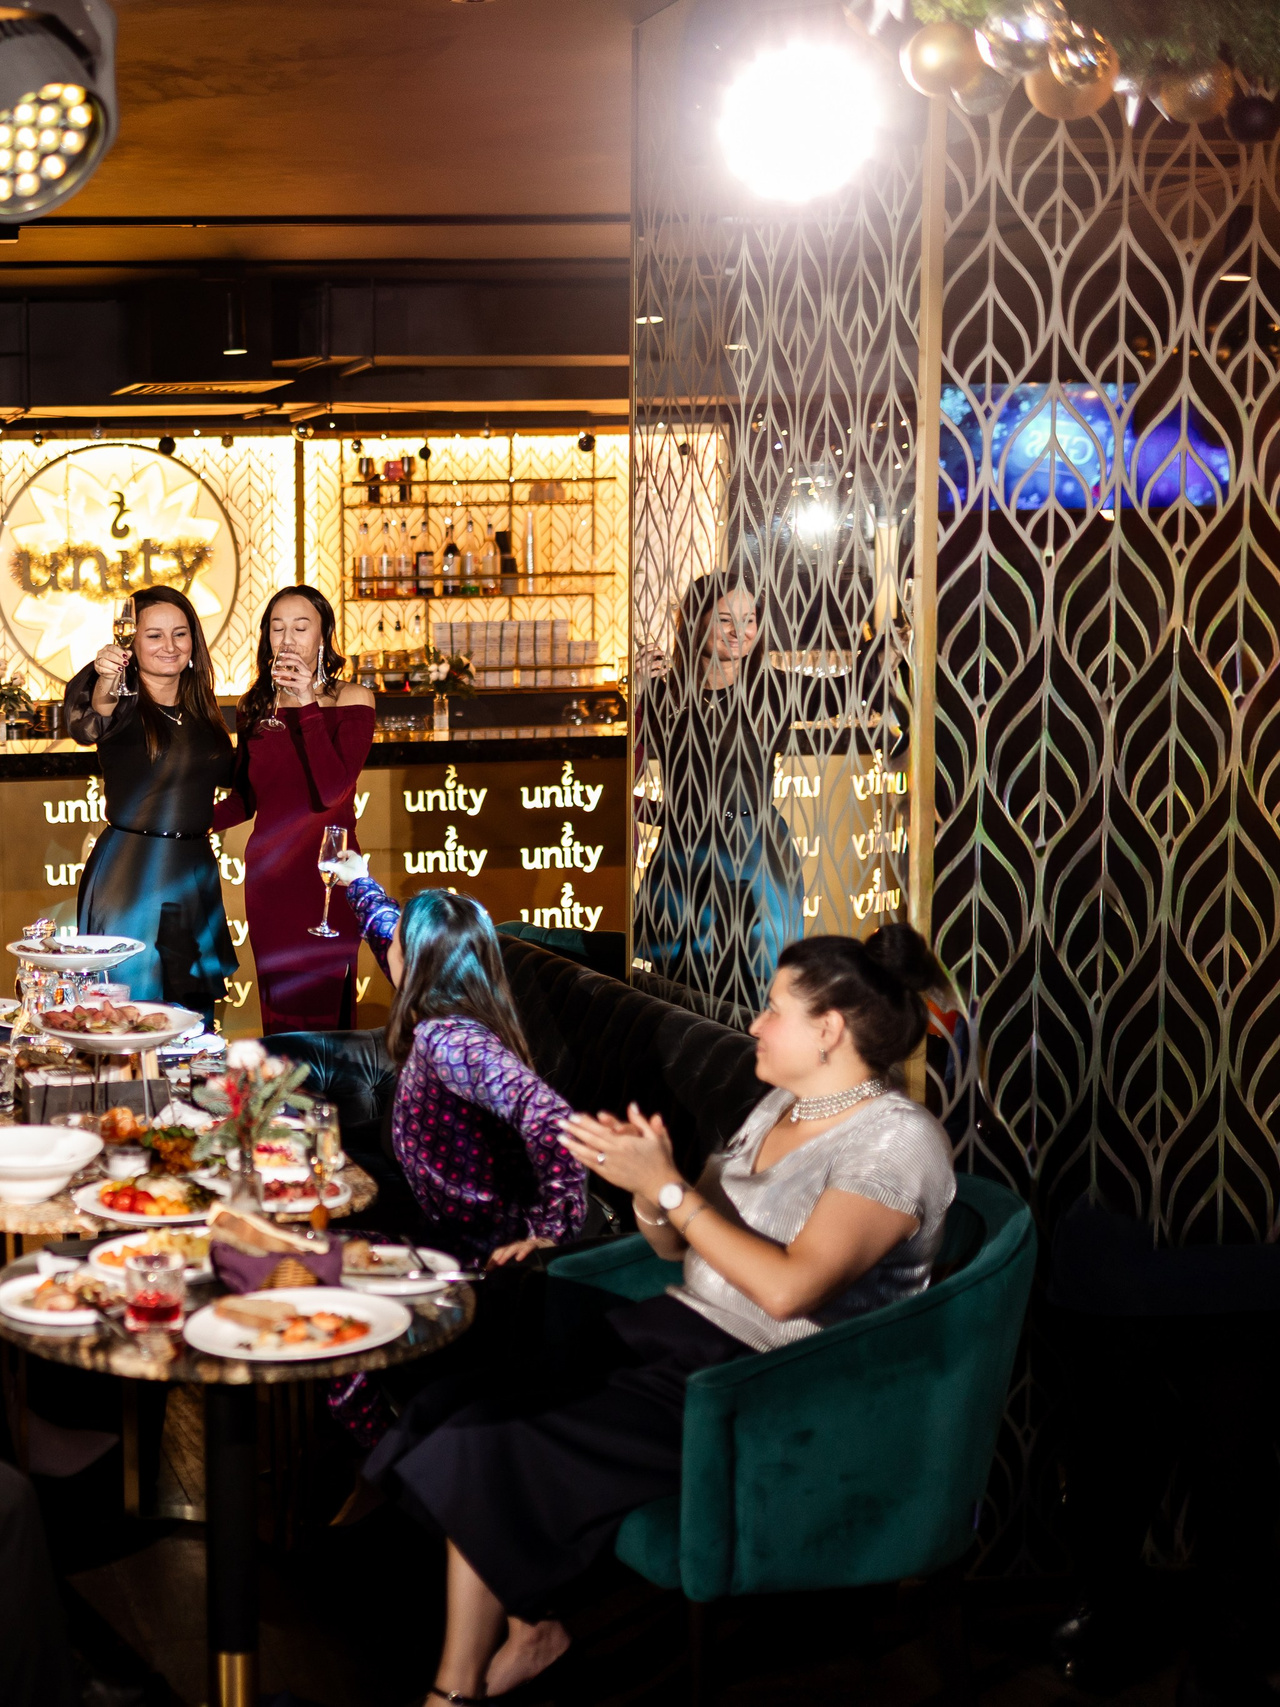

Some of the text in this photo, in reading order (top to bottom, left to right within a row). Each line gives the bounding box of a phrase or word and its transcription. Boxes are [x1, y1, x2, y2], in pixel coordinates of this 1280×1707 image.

[43, 775, 107, 824] unit
[403, 764, 488, 817] unity
[520, 760, 604, 813] unity
[403, 825, 488, 877] unity
[520, 821, 604, 873] unity
[520, 882, 604, 932] unity
